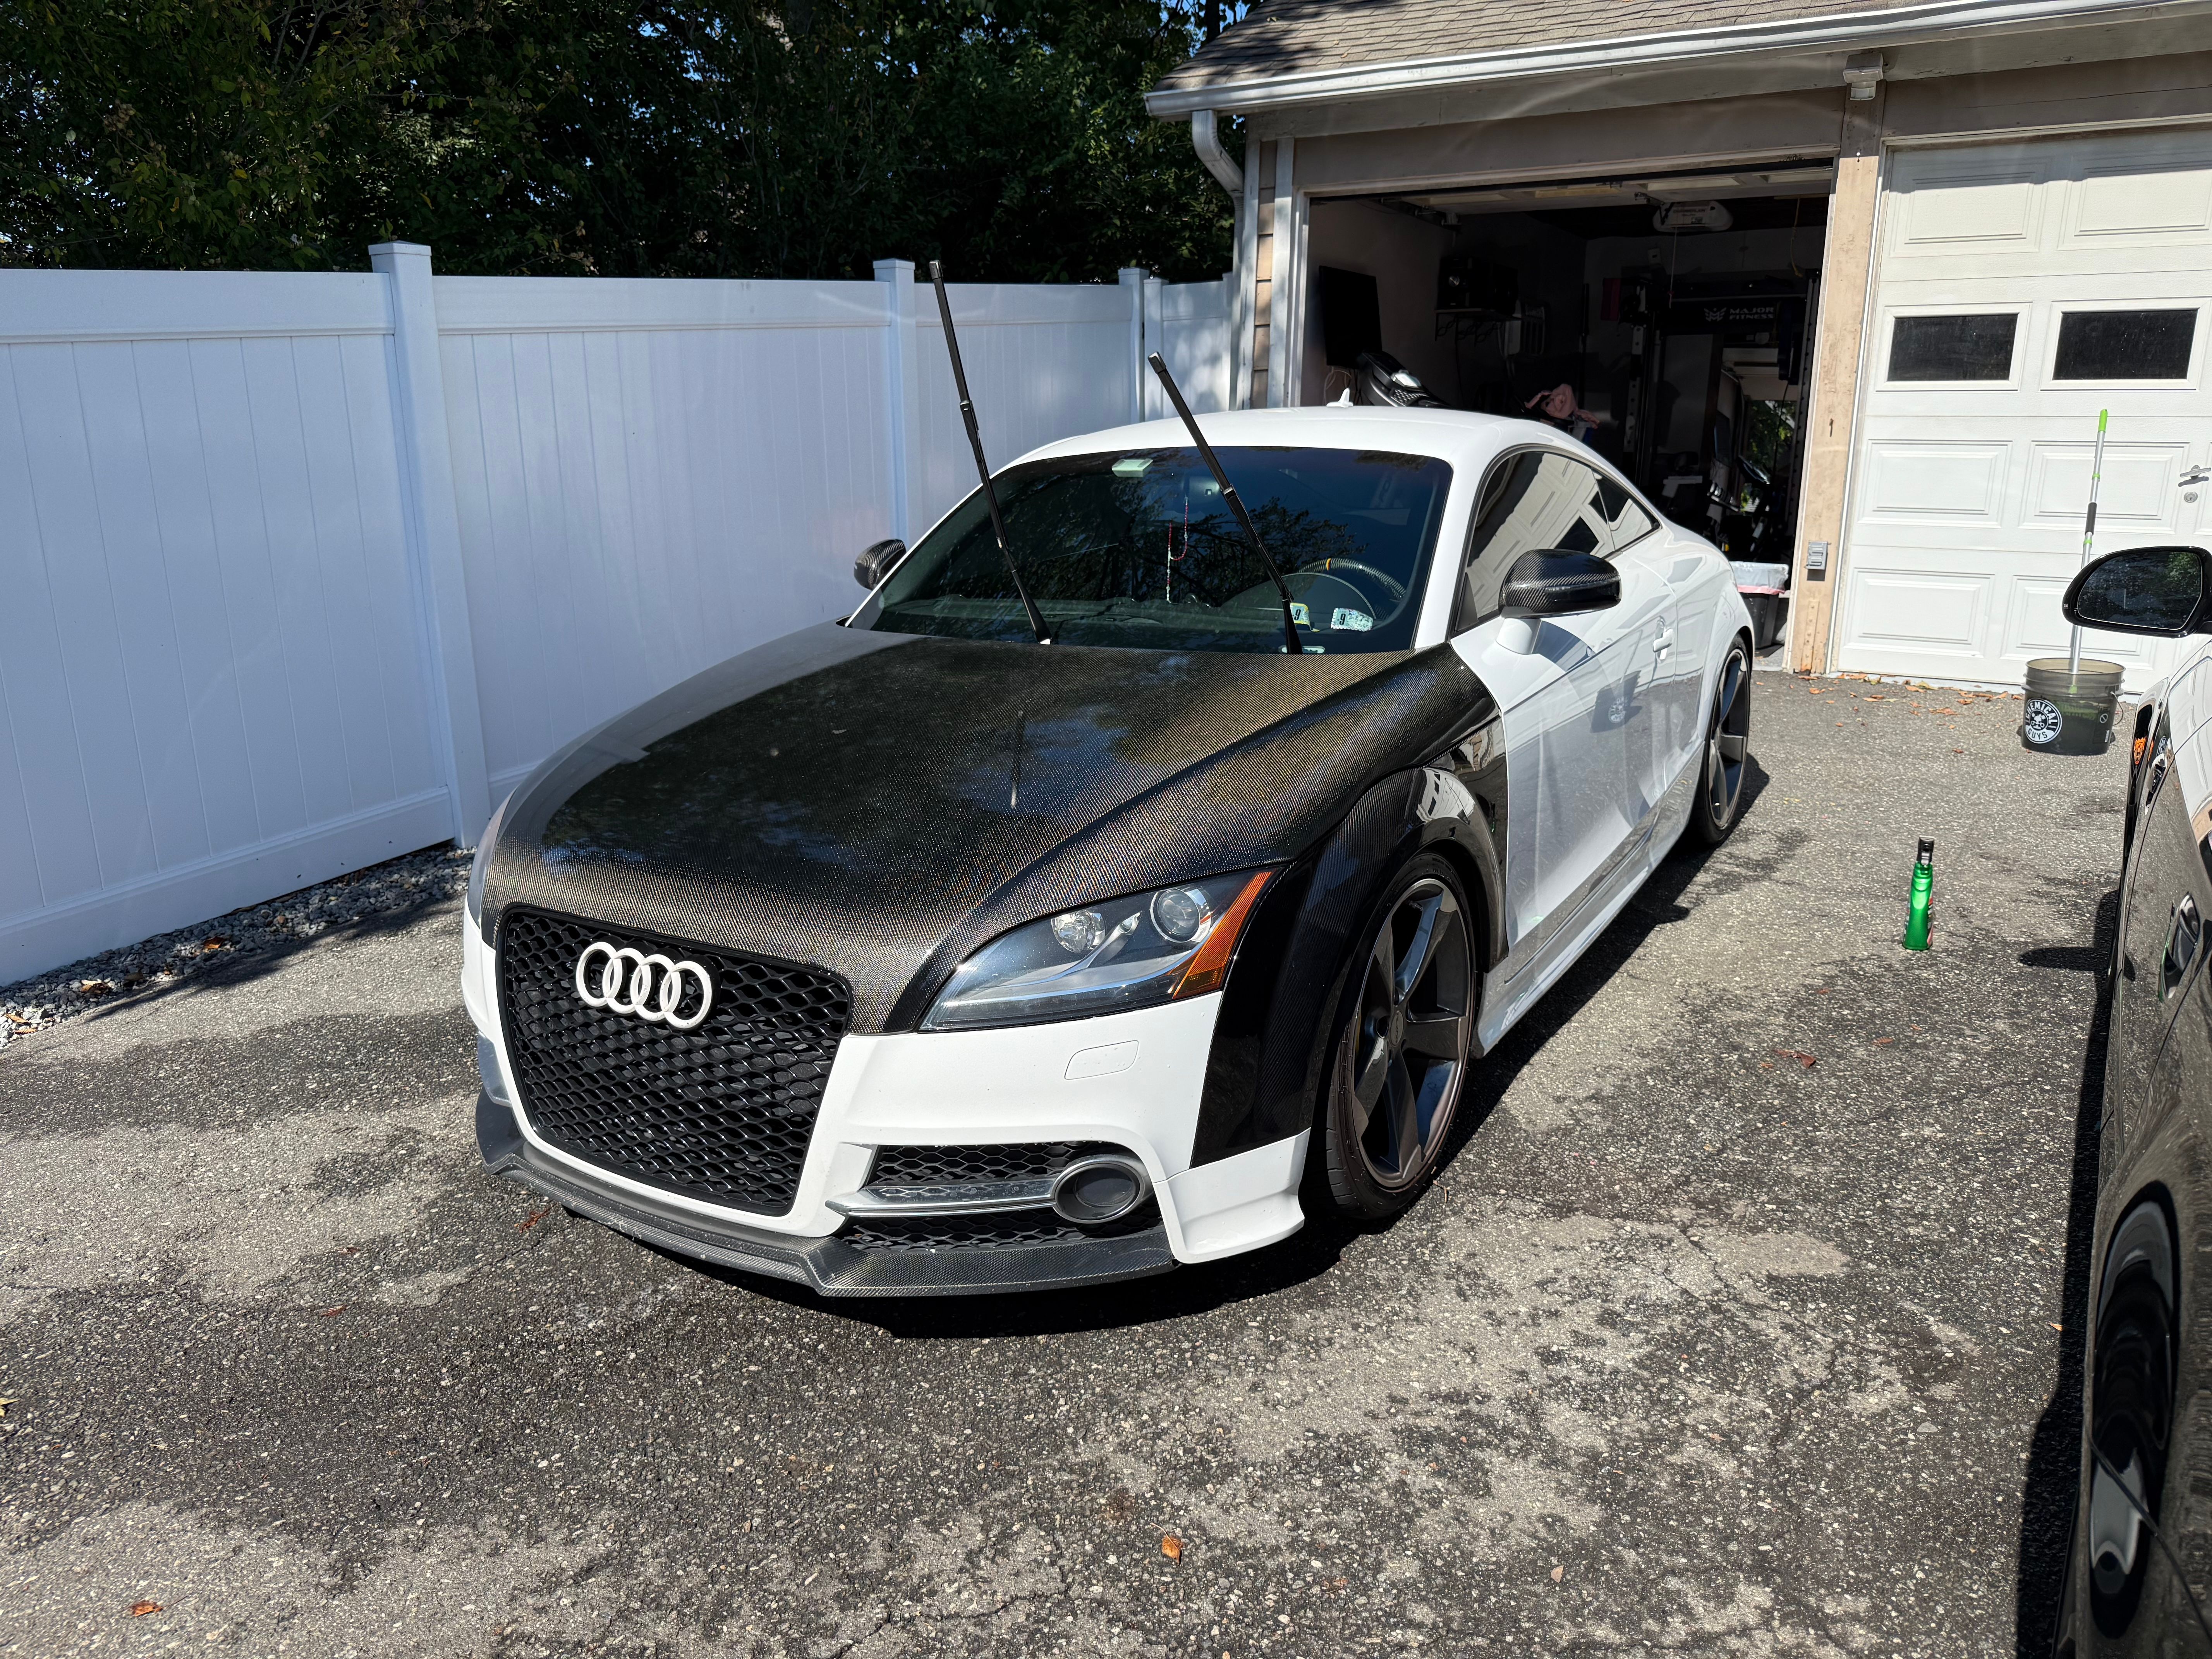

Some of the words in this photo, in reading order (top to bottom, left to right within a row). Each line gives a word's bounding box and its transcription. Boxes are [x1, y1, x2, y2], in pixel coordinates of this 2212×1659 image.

[1294, 609, 1301, 620] 9
[1339, 613, 1346, 625] 9
[2025, 701, 2058, 724] CHEMICAL
[2028, 728, 2048, 740] GUYS
